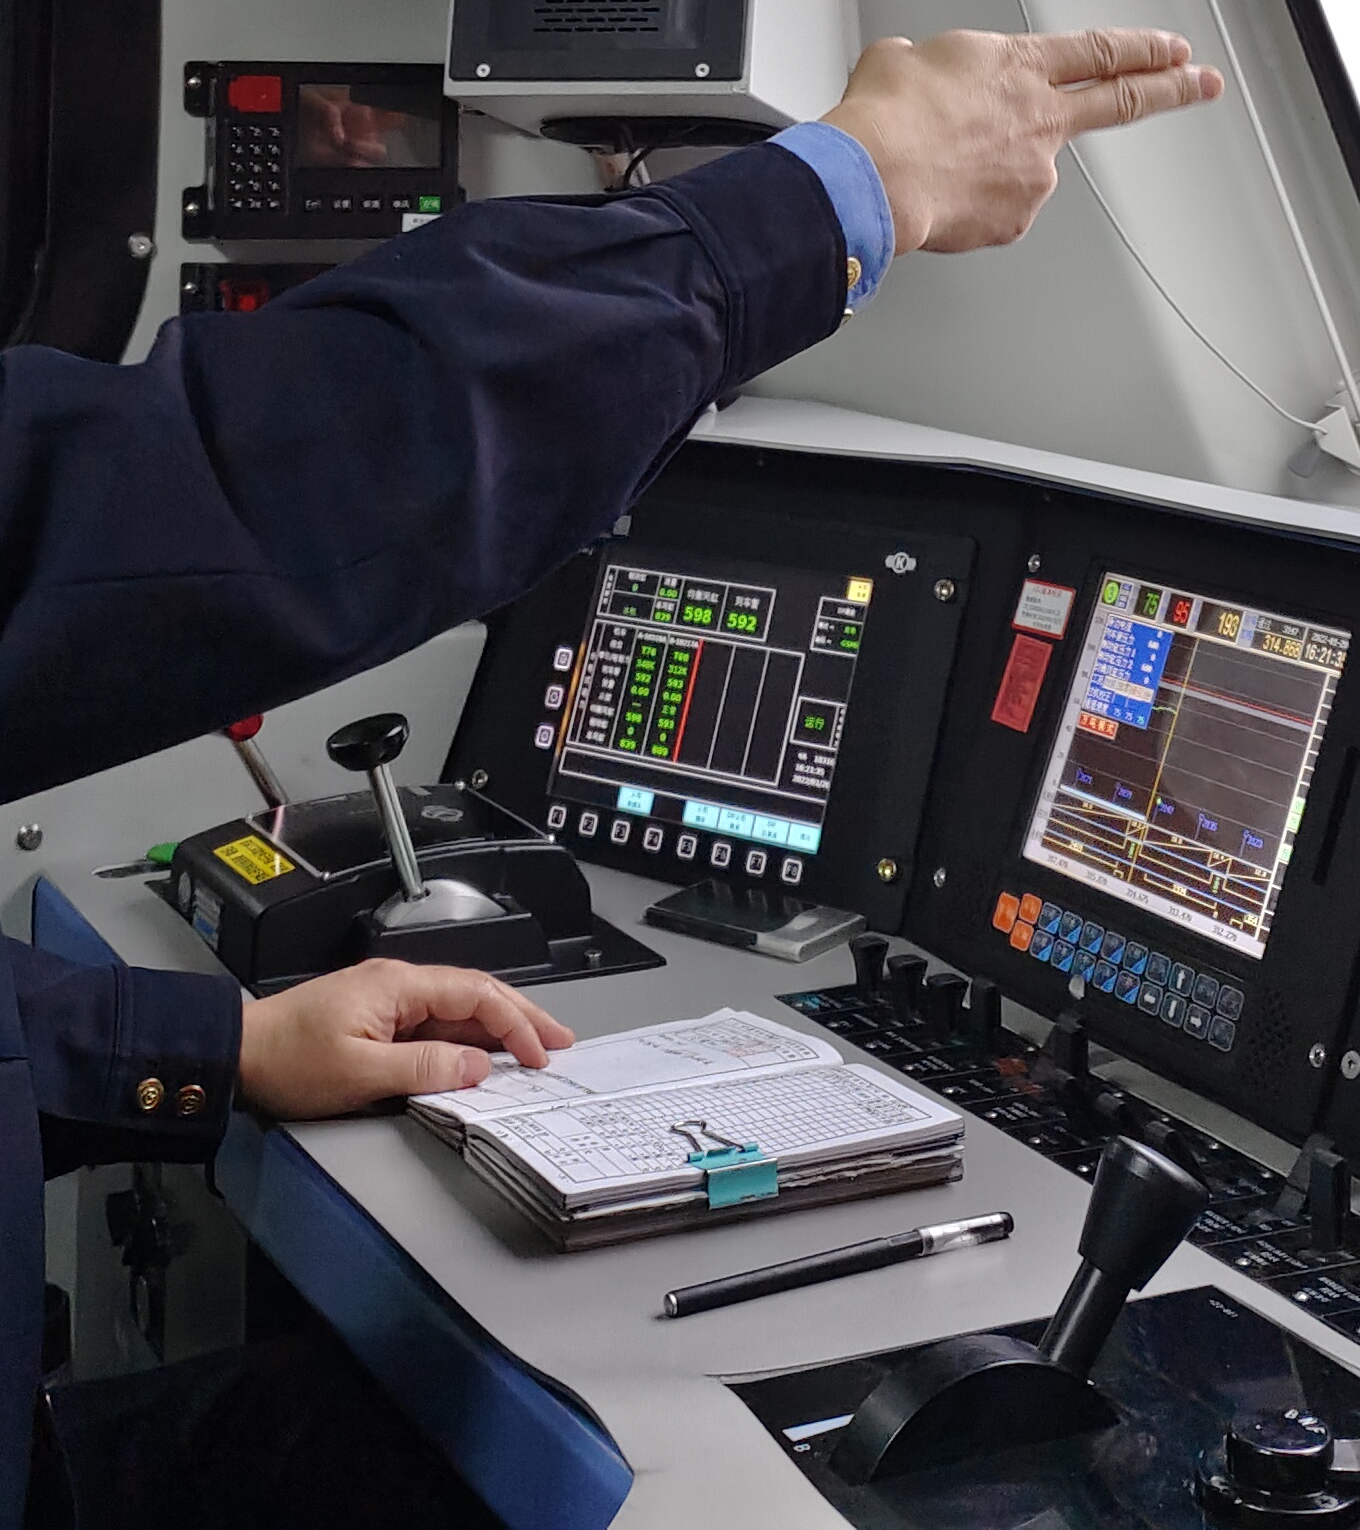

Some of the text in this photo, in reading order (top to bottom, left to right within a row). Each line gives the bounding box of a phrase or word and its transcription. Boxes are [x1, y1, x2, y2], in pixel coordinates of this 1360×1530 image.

[683, 605, 713, 626] 598
[1143, 591, 1161, 617] 75
[1173, 599, 1192, 624] 95
[727, 611, 759, 634] 592
[1218, 612, 1240, 638] 193
[804, 716, 826, 731] 运行
